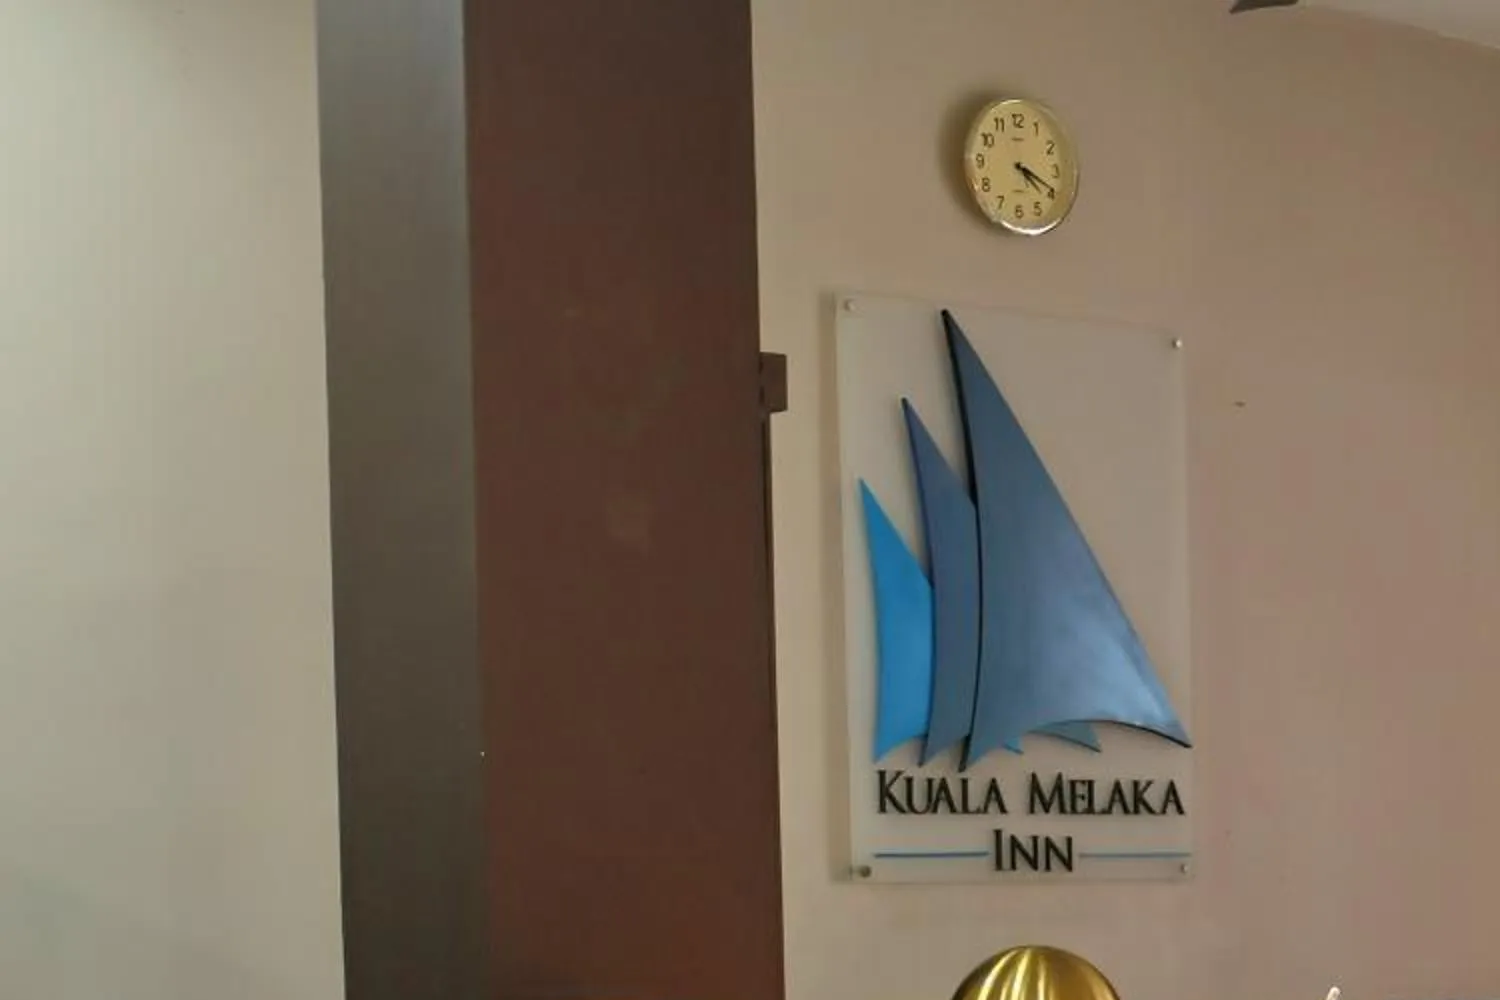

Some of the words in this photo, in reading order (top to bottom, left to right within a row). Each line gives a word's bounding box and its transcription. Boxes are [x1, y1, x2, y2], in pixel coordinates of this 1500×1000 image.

[993, 117, 1005, 132] 11
[1011, 113, 1025, 128] 12
[1033, 121, 1039, 136] 1
[981, 133, 995, 148] 10
[1045, 140, 1055, 155] 2
[975, 153, 985, 169] 9
[1051, 164, 1060, 179] 3
[981, 177, 991, 192] 8
[1047, 187, 1055, 200] 4
[996, 195, 1005, 209] 7
[1033, 202, 1042, 216] 5
[1015, 205, 1024, 218] 6
[877, 769, 1008, 815] KUALA
[1028, 771, 1186, 815] MELAKA
[992, 828, 1074, 872] INN
